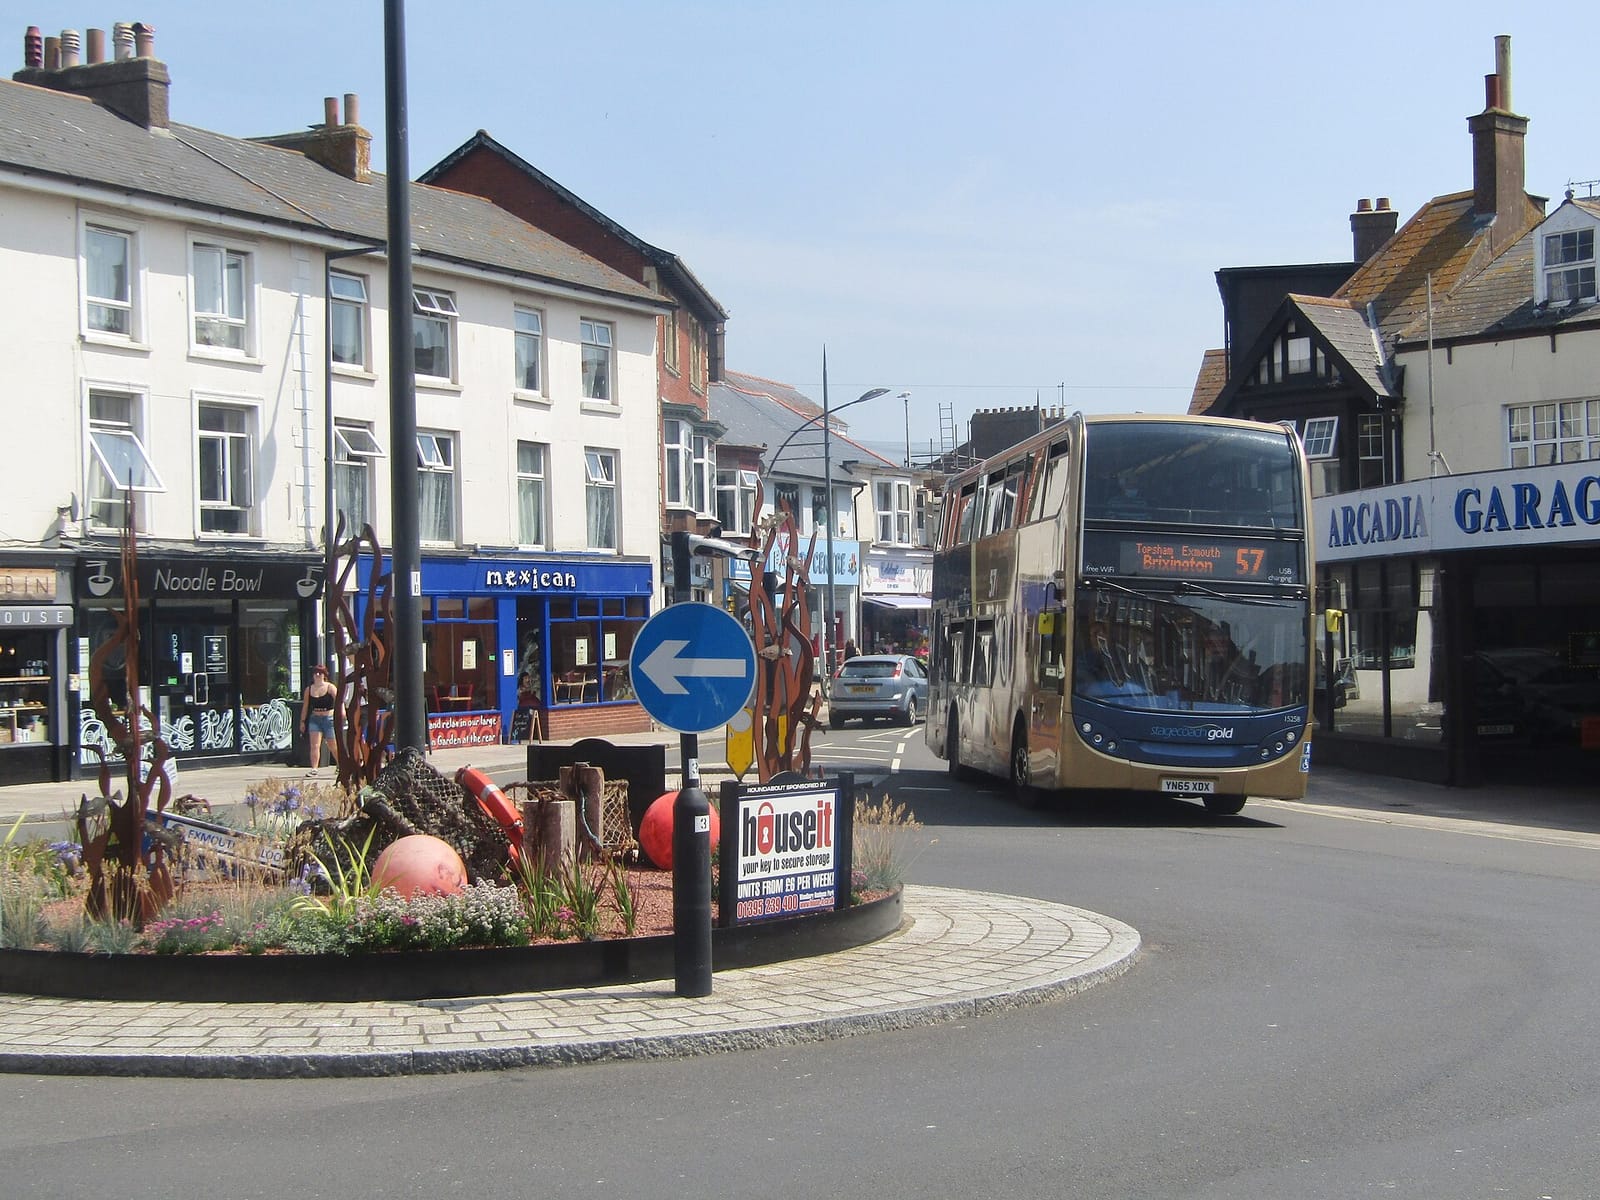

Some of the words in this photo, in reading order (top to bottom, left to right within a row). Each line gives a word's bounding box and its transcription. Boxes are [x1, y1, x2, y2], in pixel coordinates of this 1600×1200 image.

[1328, 493, 1429, 548] ARCADIA
[1182, 545, 1221, 558] Exmouth
[1236, 548, 1265, 575] 57
[154, 567, 217, 591] Noodle
[221, 568, 264, 591] Bowl
[486, 568, 576, 589] mexican
[1278, 567, 1292, 575] USB
[5, 575, 49, 593] BIN
[4, 611, 63, 624] OUSE
[480, 715, 497, 728] large
[437, 733, 462, 746] Garden
[470, 731, 482, 743] the
[1207, 727, 1233, 740] gold
[747, 784, 785, 793] ROUNDABOUT
[786, 782, 819, 790] SPONSORED
[1166, 781, 1190, 791] YN65
[1192, 782, 1210, 791] XDX
[742, 861, 759, 877] your
[760, 858, 772, 874] key
[773, 857, 780, 871] to
[781, 855, 805, 870] secure
[805, 852, 831, 867] storage
[737, 881, 761, 899] UNITS
[762, 879, 784, 896] FROM
[785, 877, 795, 892] £6
[797, 875, 811, 891] PER
[812, 871, 834, 889] WEEK!
[737, 899, 764, 919] 01395
[764, 896, 781, 914] 239
[782, 894, 799, 911] 400
